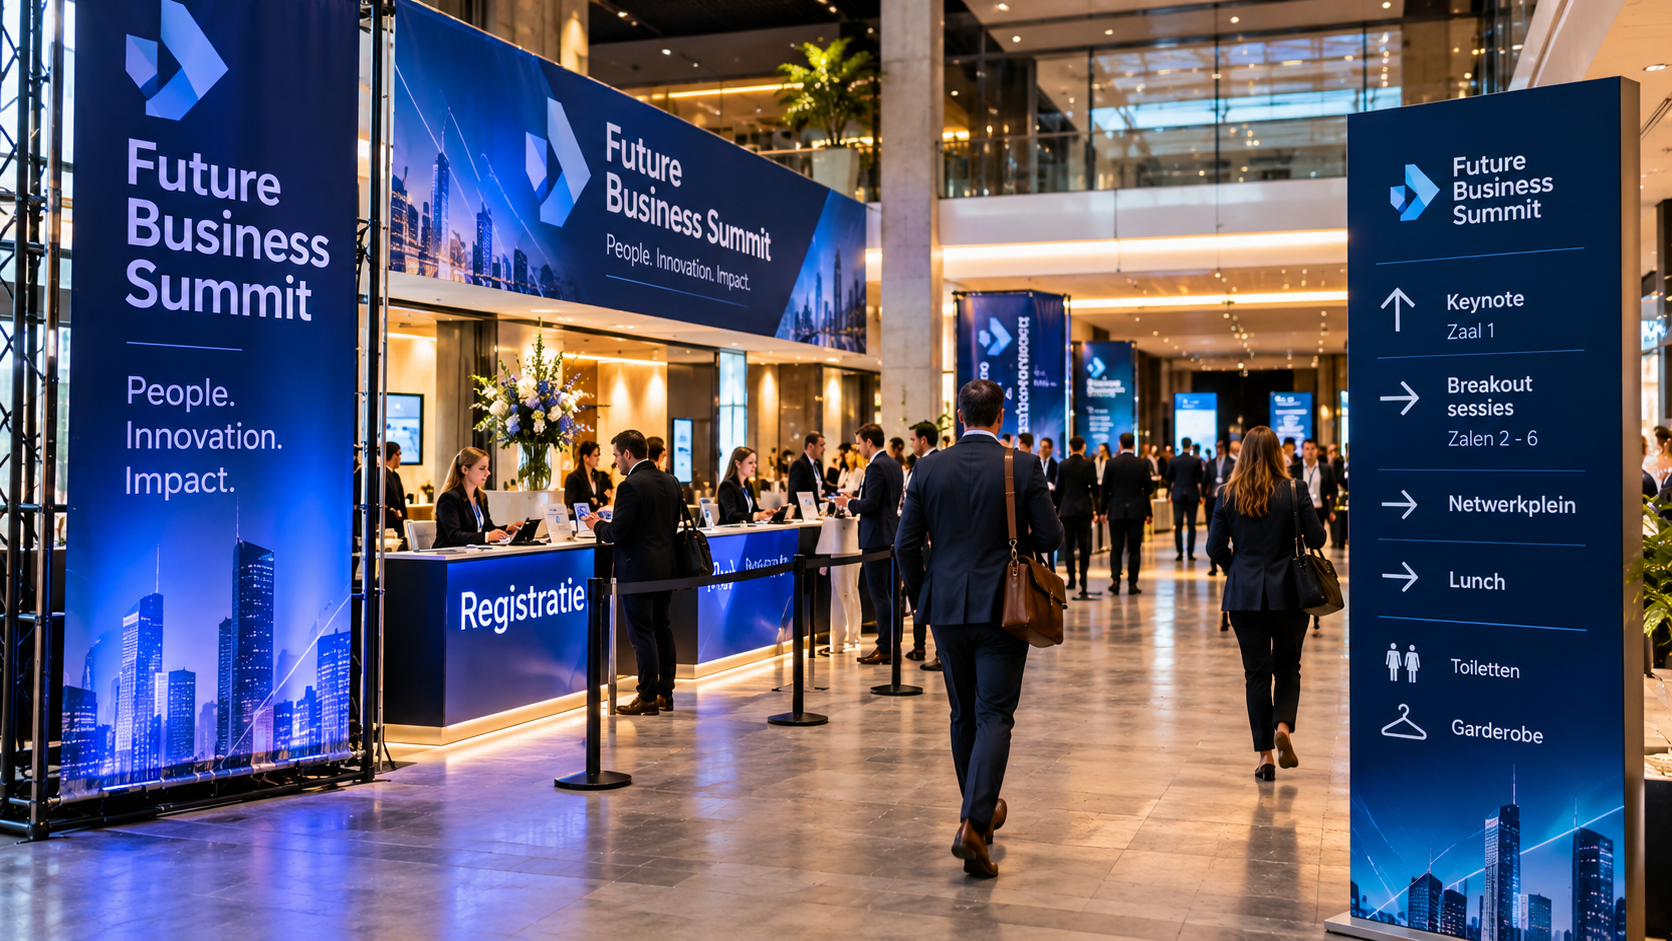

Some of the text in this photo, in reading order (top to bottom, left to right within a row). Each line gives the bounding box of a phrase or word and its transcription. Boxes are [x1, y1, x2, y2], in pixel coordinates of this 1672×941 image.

[606, 121, 683, 188] Future
[1453, 155, 1527, 177] Future
[128, 137, 281, 207] Future
[1453, 177, 1554, 202] Business
[606, 171, 772, 262] Business Summit
[1453, 199, 1542, 226] Summit
[127, 197, 330, 268] Business
[606, 233, 751, 292] People. Innovation. Impact.
[125, 258, 312, 322] Summit
[1447, 291, 1525, 314] Keynote
[1447, 322, 1494, 340] Zaal 1
[127, 375, 236, 413] People.
[1447, 374, 1533, 394] Breakout
[1447, 398, 1514, 417] sessies
[125, 420, 283, 450] Innovation.
[1448, 429, 1494, 447] Zalen
[1499, 429, 1510, 447] 2
[1527, 429, 1538, 447] 6
[125, 466, 235, 502] Impact.
[1449, 493, 1577, 518] Netwerkplein
[1448, 569, 1506, 591] Lunch
[460, 577, 585, 635] Registratie
[1450, 658, 1521, 679] Toiletten
[1450, 718, 1544, 744] Garderobe
